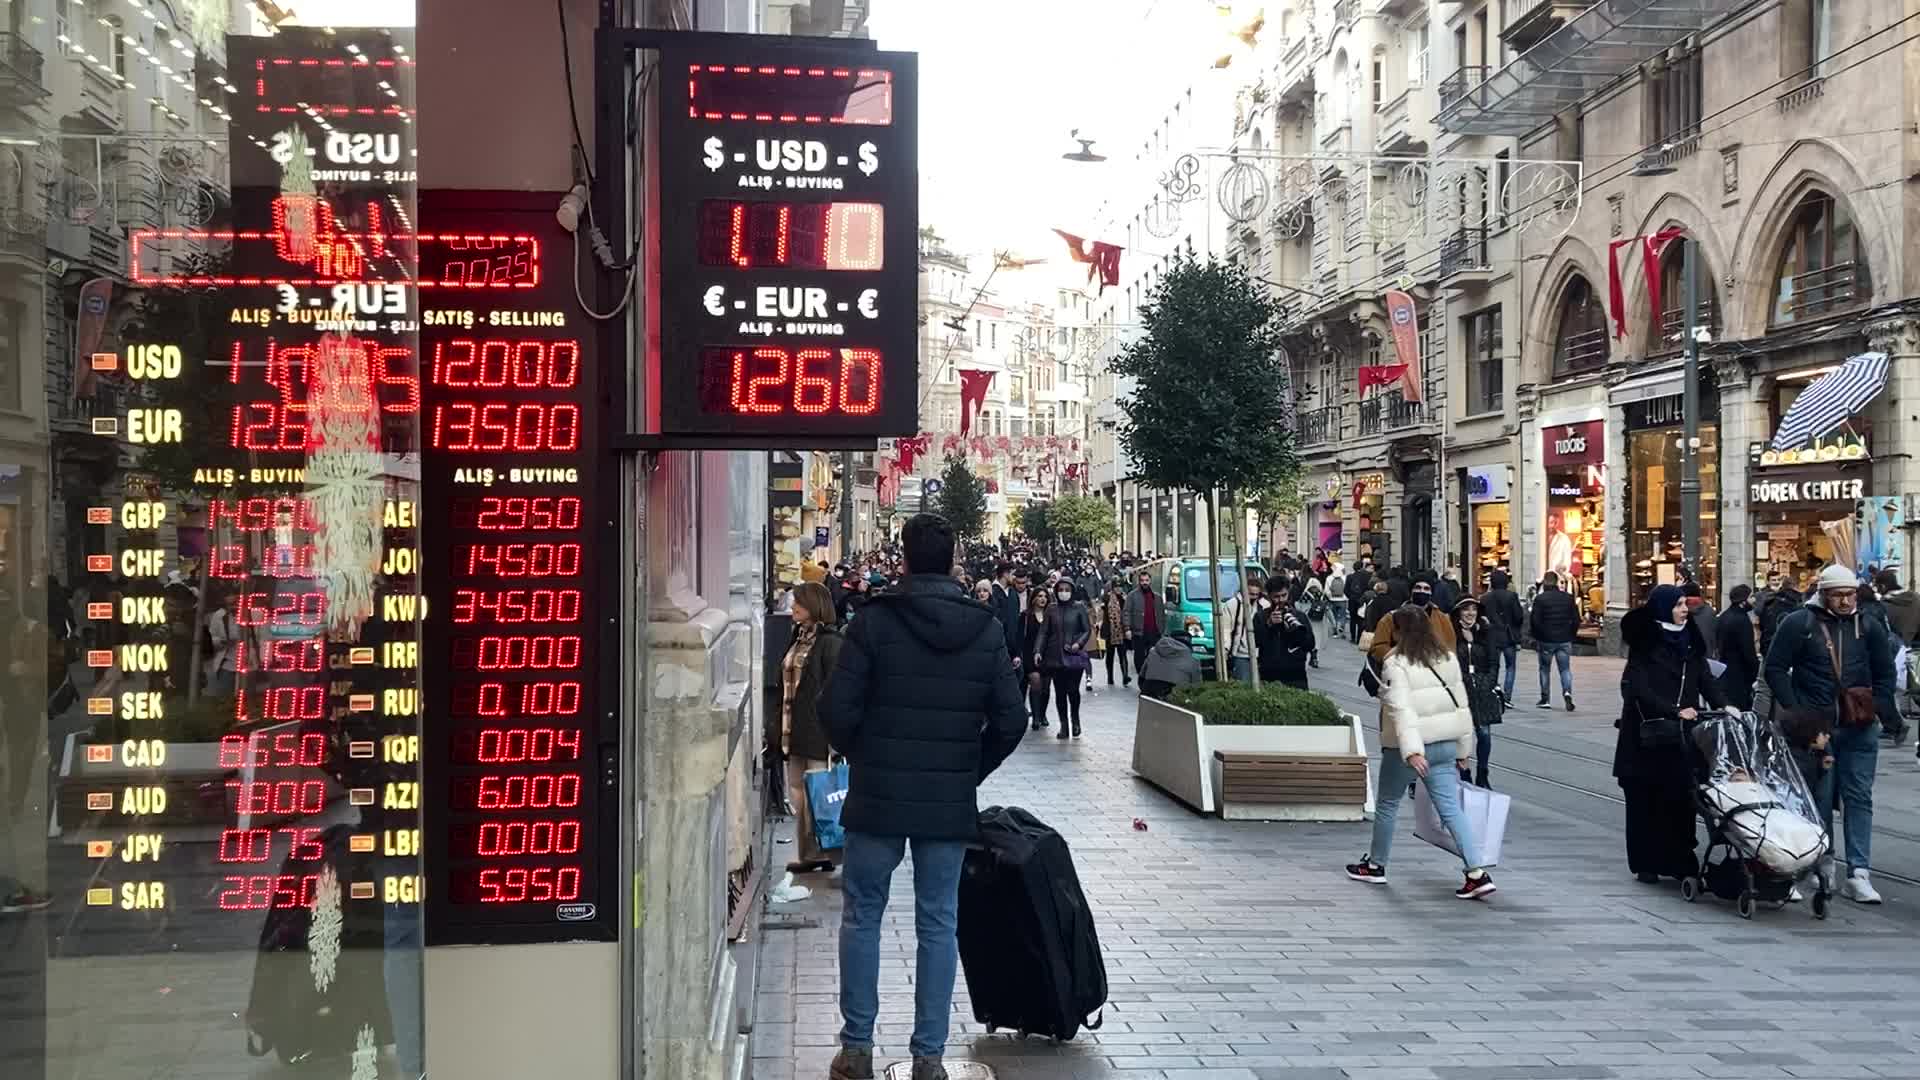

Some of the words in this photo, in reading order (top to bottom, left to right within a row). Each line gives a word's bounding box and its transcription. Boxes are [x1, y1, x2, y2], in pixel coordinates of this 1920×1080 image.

[703, 136, 725, 172] $
[756, 139, 828, 172] USD
[858, 141, 879, 177] $
[785, 176, 844, 190] BUYING
[703, 285, 725, 316] €
[756, 286, 829, 318] EUR
[857, 288, 879, 319] €
[230, 309, 271, 328] ALIŞ
[287, 309, 357, 324] BUYING
[423, 310, 474, 330] SATIŞ
[489, 311, 565, 327] SELLING
[785, 323, 844, 335] BUYING
[127, 344, 182, 380] USD
[127, 408, 182, 444] EUR
[1555, 437, 1587, 455] TUDORS
[194, 468, 234, 487] ALIŞ
[250, 468, 305, 483] BUYIN
[454, 468, 494, 486] ALIŞ
[509, 468, 578, 483] BUYING
[1802, 479, 1864, 499] CENTER
[1550, 487, 1581, 495] TUDORS
[121, 502, 166, 529] GBP
[121, 550, 165, 577] CHF
[121, 597, 166, 624] DKK
[122, 644, 168, 672] NOK
[121, 692, 164, 720] SEK
[122, 740, 166, 767] CAD
[121, 787, 166, 814] AUD
[121, 835, 162, 862] JPY
[121, 882, 164, 910] SAR
